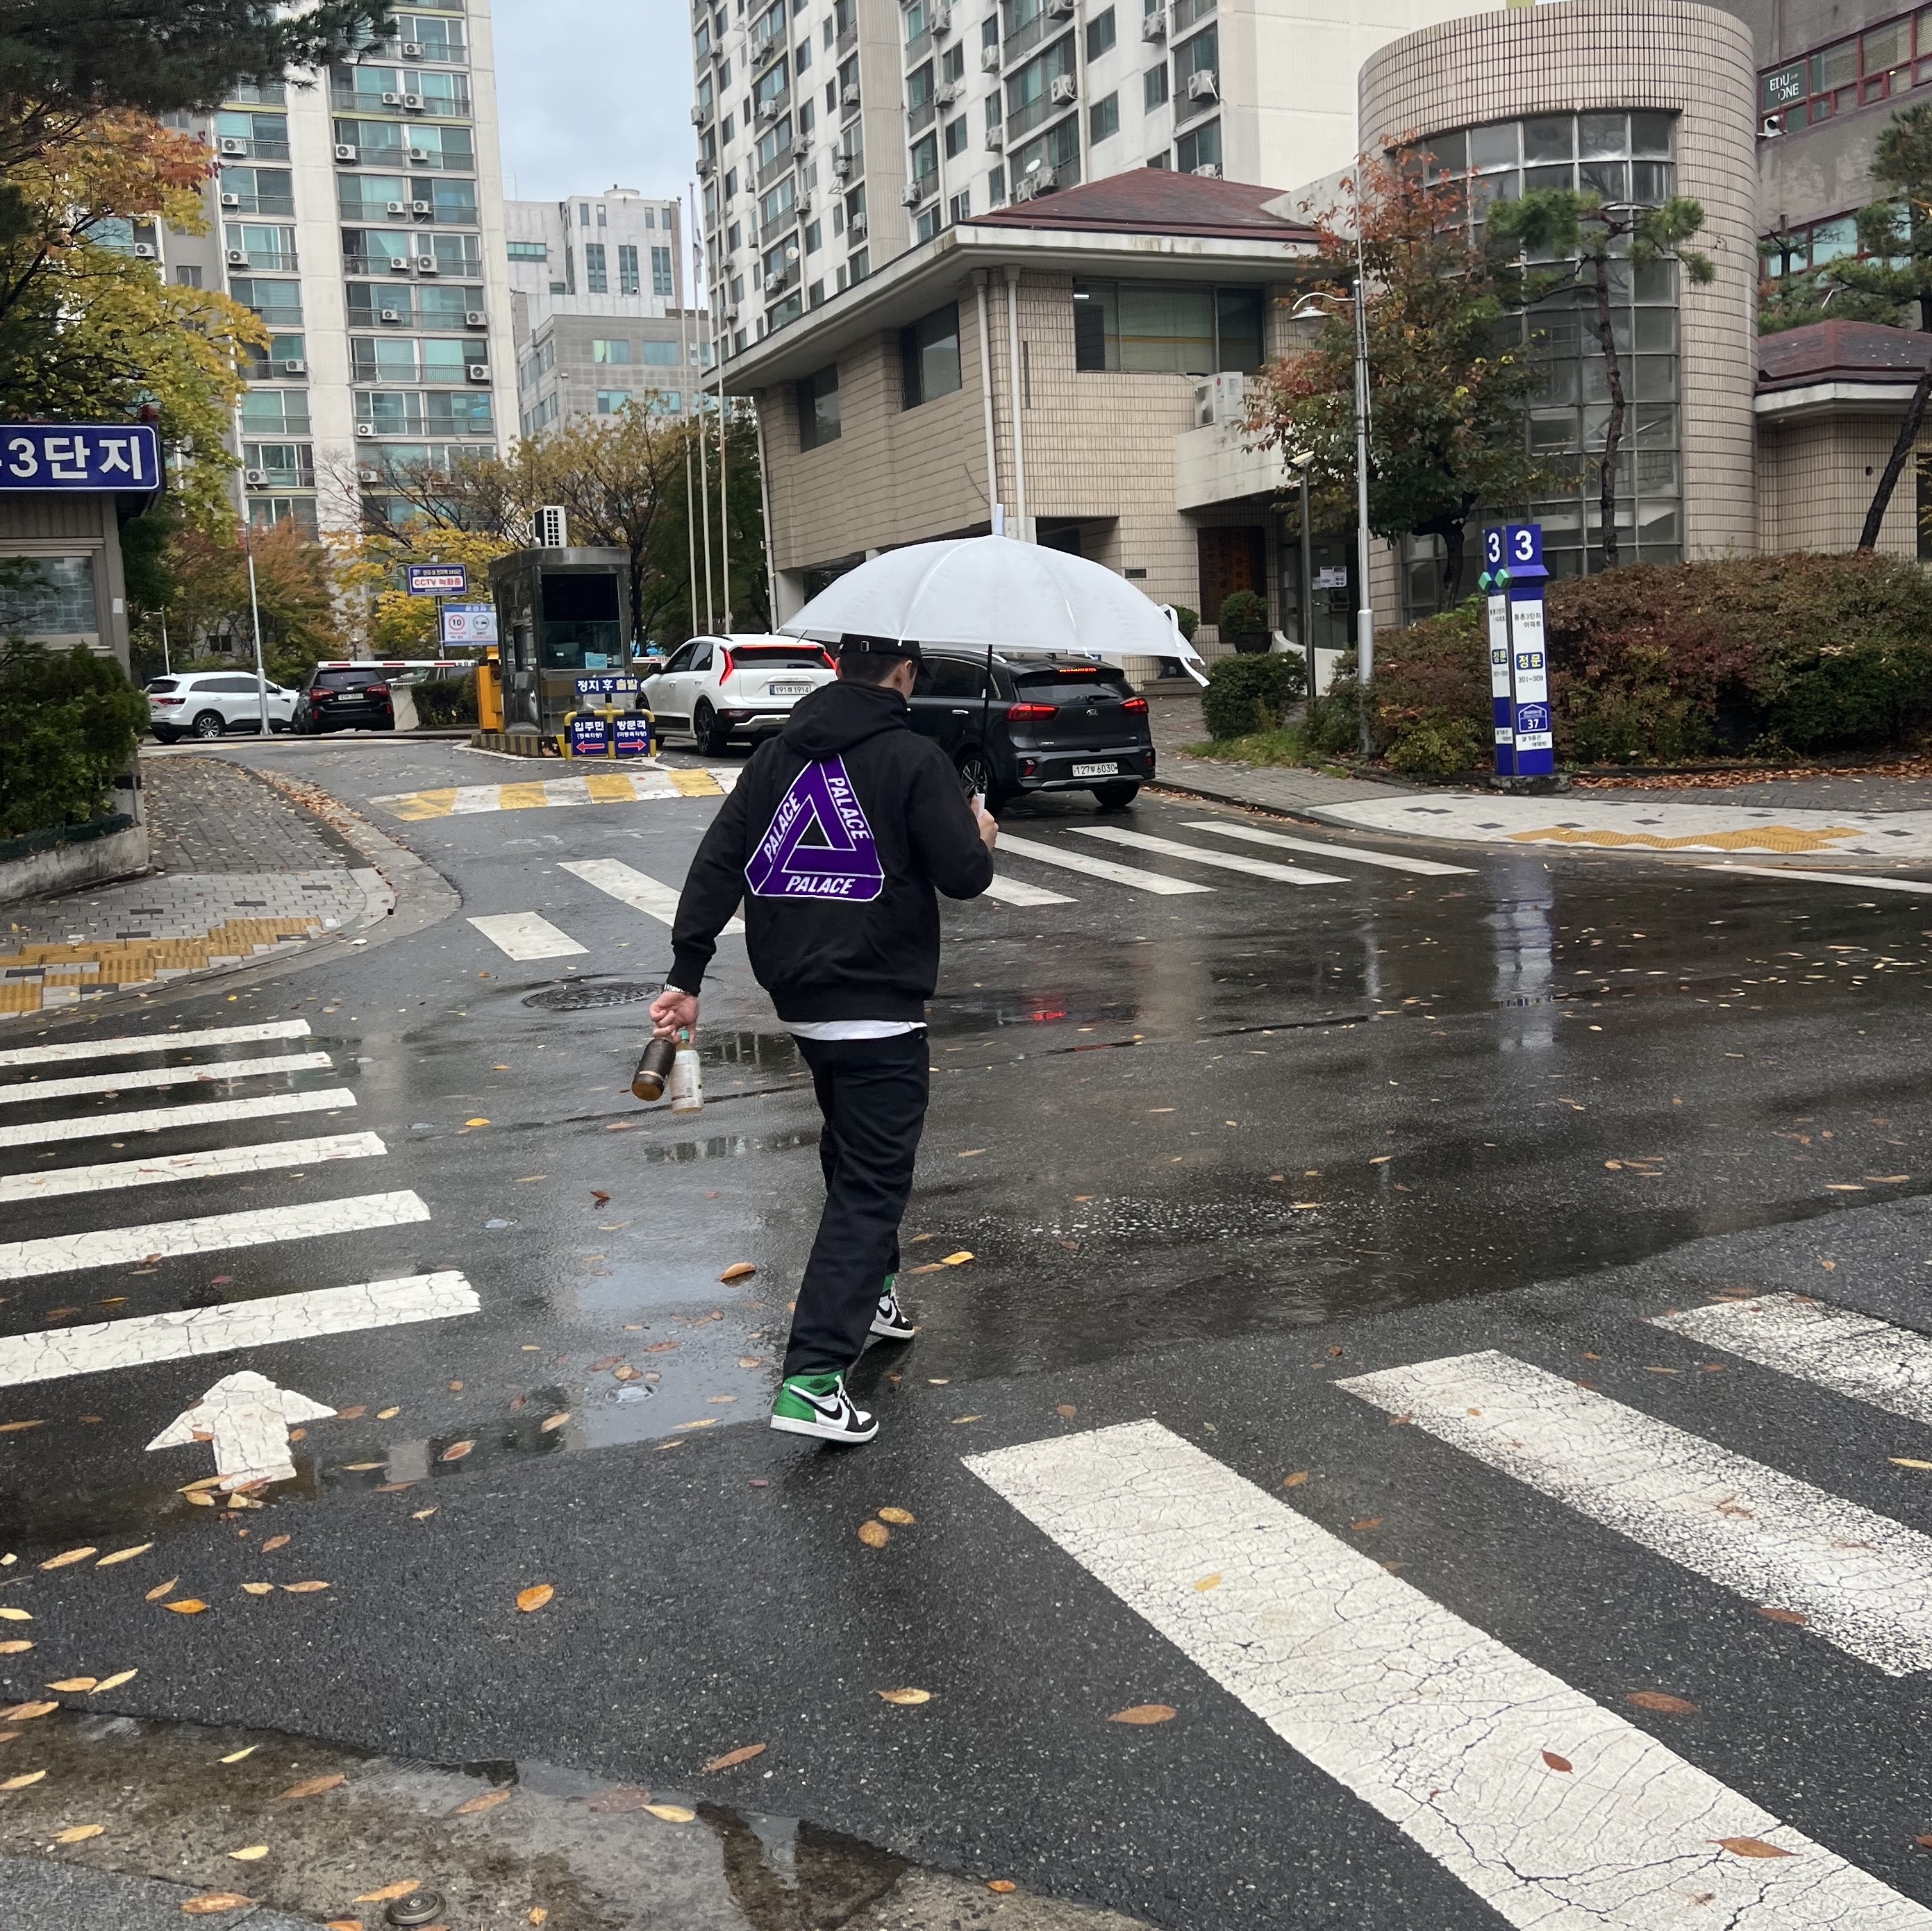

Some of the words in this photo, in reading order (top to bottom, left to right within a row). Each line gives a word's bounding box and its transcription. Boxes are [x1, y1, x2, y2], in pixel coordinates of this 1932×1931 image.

[1770, 73, 1790, 91] EDU
[1778, 83, 1799, 101] ONE
[0, 435, 142, 480] 3단지
[1488, 532, 1501, 563] 3
[1515, 530, 1533, 561] 3
[415, 578, 437, 587] CCTV
[1519, 653, 1542, 669] 정문
[577, 680, 599, 692] 정지
[602, 679, 614, 692] 후
[616, 678, 638, 691] 출발
[574, 721, 605, 732] 입주민
[617, 719, 646, 731] 방문객
[1528, 719, 1540, 730] 37
[1097, 764, 1115, 774] 6030
[828, 777, 870, 839] PALACE
[763, 791, 800, 863] PALACE
[785, 875, 856, 894] PALACE
